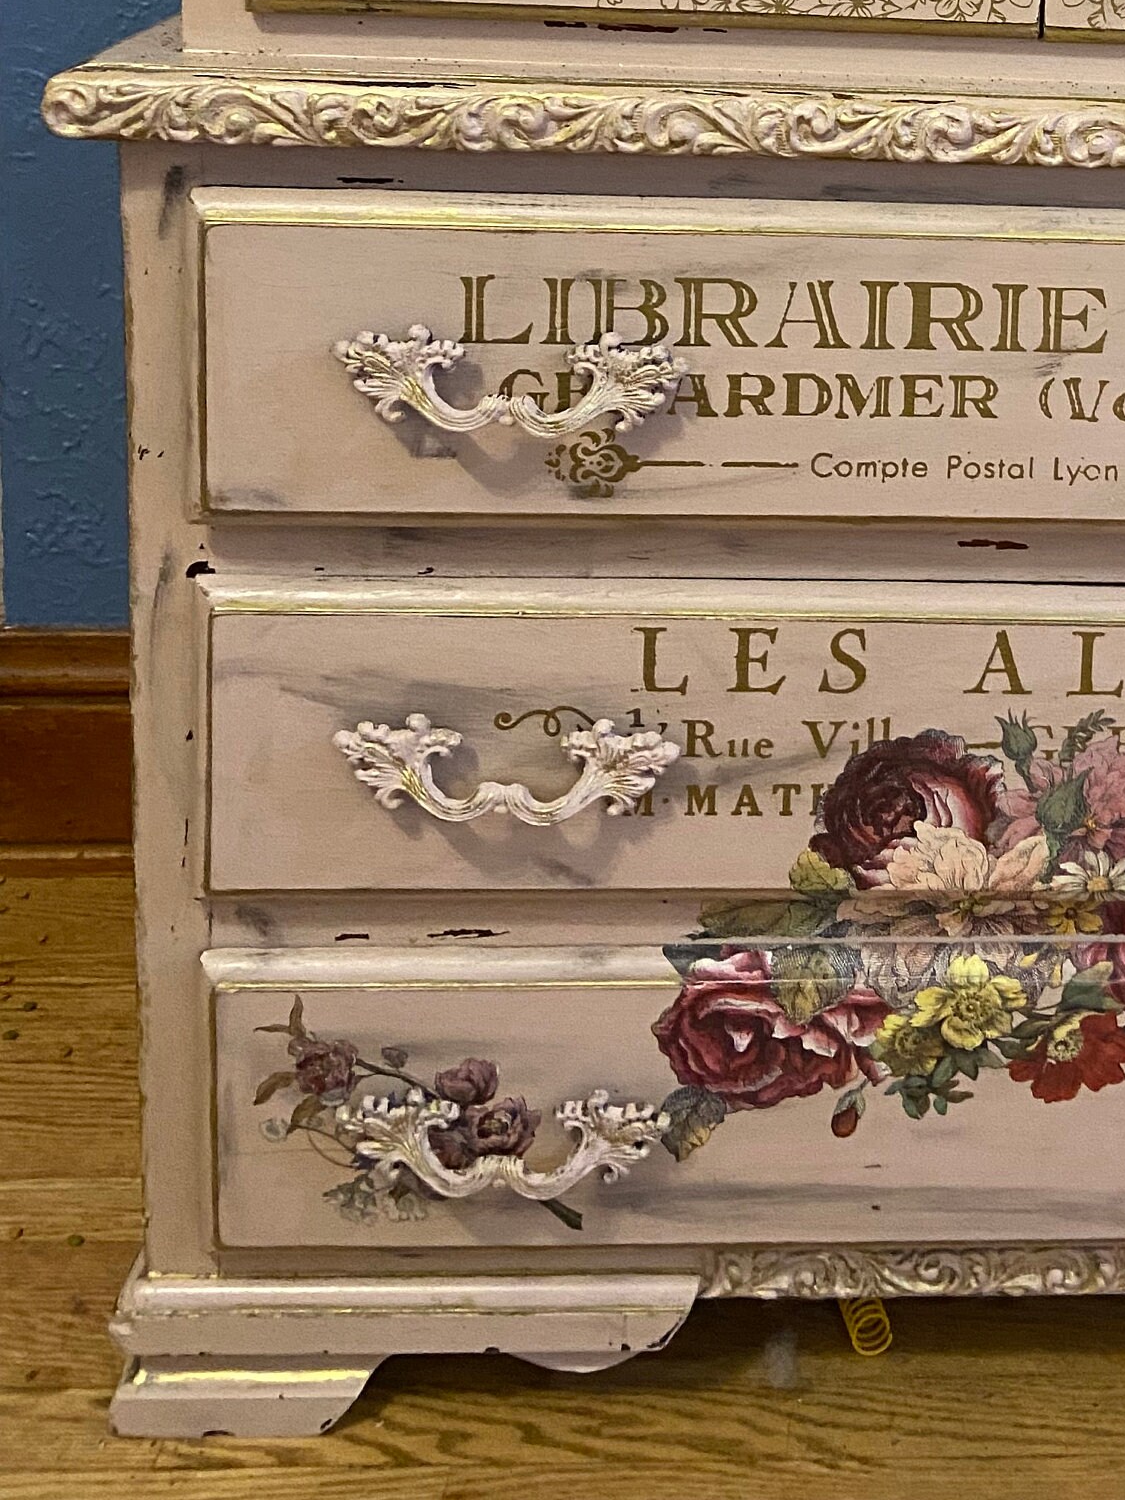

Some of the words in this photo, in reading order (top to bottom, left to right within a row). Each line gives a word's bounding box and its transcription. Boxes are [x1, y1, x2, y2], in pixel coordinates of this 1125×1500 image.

[457, 274, 1109, 354] LIBRAIRIE
[810, 452, 929, 484] Compte
[946, 454, 1035, 480] Postal
[1053, 456, 1119, 487] Lyon
[631, 626, 867, 696] LES
[681, 719, 775, 759] Rue
